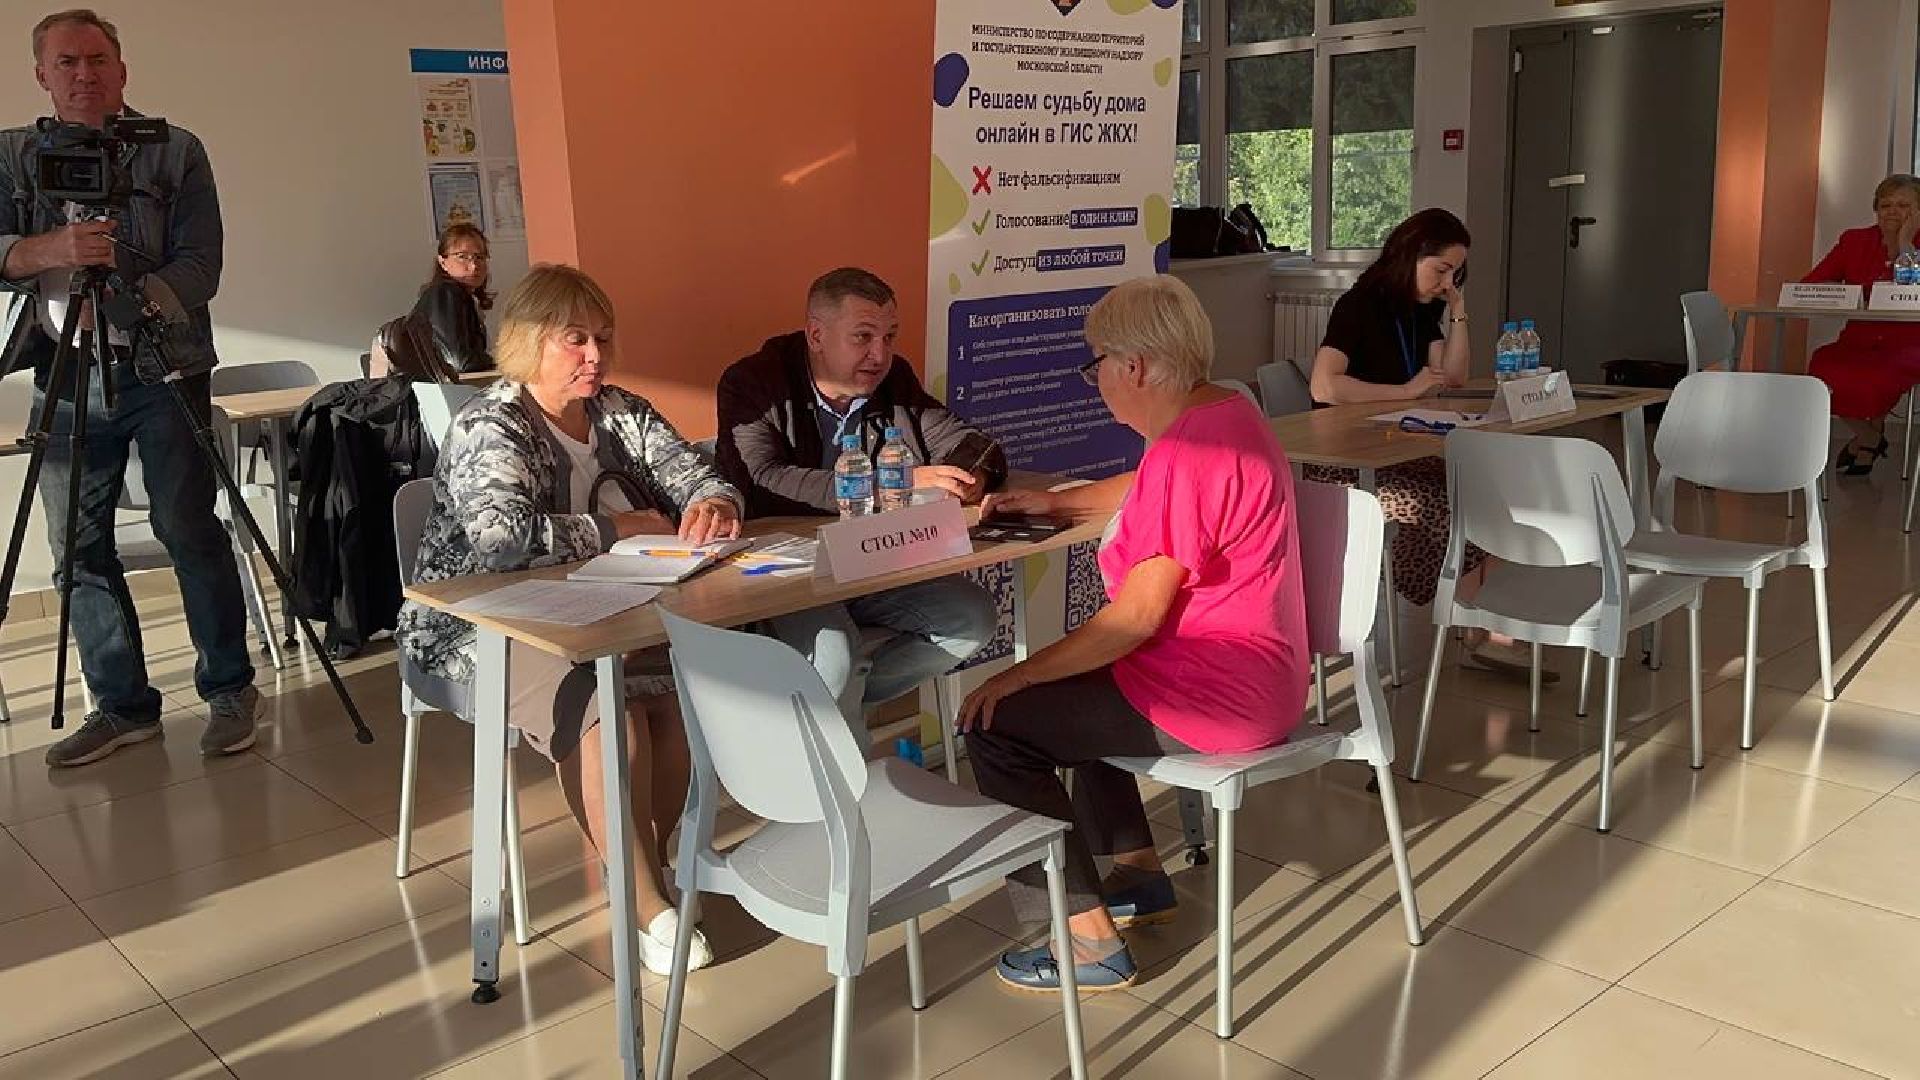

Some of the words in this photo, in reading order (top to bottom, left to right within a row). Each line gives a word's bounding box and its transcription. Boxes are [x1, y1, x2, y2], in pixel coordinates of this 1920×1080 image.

[972, 24, 1034, 38] МИНИСТЕРСТВО
[1035, 29, 1047, 39] ПО
[1048, 30, 1100, 43] СОДЕРЖАНИЮ
[1101, 33, 1145, 46] ТЕРРИТОРИЙ
[972, 42, 979, 51] И
[980, 42, 1058, 55] ГОСУДАРСТВЕННОМУ
[1059, 48, 1110, 59] ЖИЛИЩНОМУ
[1110, 50, 1144, 61] НАДЗОРУ
[1017, 61, 1070, 73] МОСКОВСКОЙ
[1071, 64, 1103, 74] ОБЛАСТИ
[968, 87, 1037, 110] Решаем
[1043, 90, 1101, 117] судьбу
[1104, 95, 1147, 115] дома
[976, 121, 1040, 143] онлайн
[1044, 128, 1055, 143] в
[1061, 123, 1094, 143] ГИС
[1098, 122, 1138, 143] ЖКХ!
[998, 171, 1018, 187] Нет
[1020, 169, 1121, 190] фальсификациям
[996, 213, 1070, 229] Голосование
[1071, 215, 1079, 225] в
[1080, 212, 1108, 226] один
[1109, 210, 1136, 223] клик
[994, 255, 1036, 273] Доступ
[1038, 255, 1051, 267] из
[1053, 249, 1089, 267] любой
[1091, 250, 1123, 264] точки
[968, 313, 989, 328] Как
[990, 306, 1066, 329] организовать
[958, 345, 965, 361] 1
[956, 386, 965, 400] 2
[861, 533, 905, 554] СТОЛ
[909, 525, 938, 544] №10
